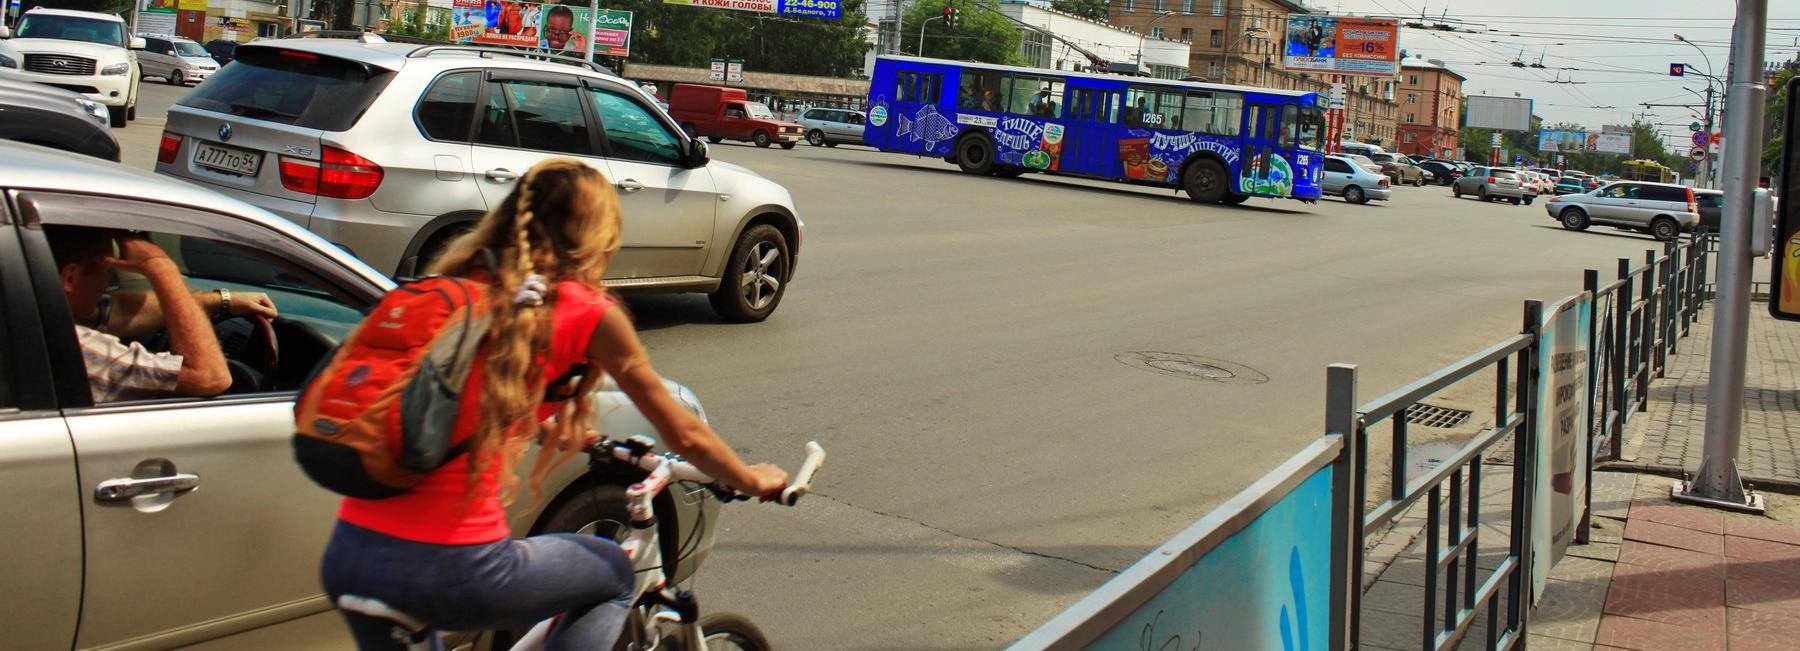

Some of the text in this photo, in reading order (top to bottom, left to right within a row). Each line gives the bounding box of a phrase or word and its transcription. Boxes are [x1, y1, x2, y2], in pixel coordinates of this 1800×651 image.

[732, 1, 772, 11] ГОЛОВЫ
[784, 0, 837, 9] 22-46-900
[784, 7, 825, 16] Д.Бедного,
[1142, 112, 1162, 124] 1265
[1002, 117, 1044, 141] ТИШЕ
[993, 128, 1030, 150] ЕДЕШЬ
[1149, 131, 1197, 151] ЛУЧШЕ
[198, 147, 255, 168] А777ТО 54
[1187, 141, 1239, 166] АППЕТИТ
[1297, 153, 1309, 166] 1265
